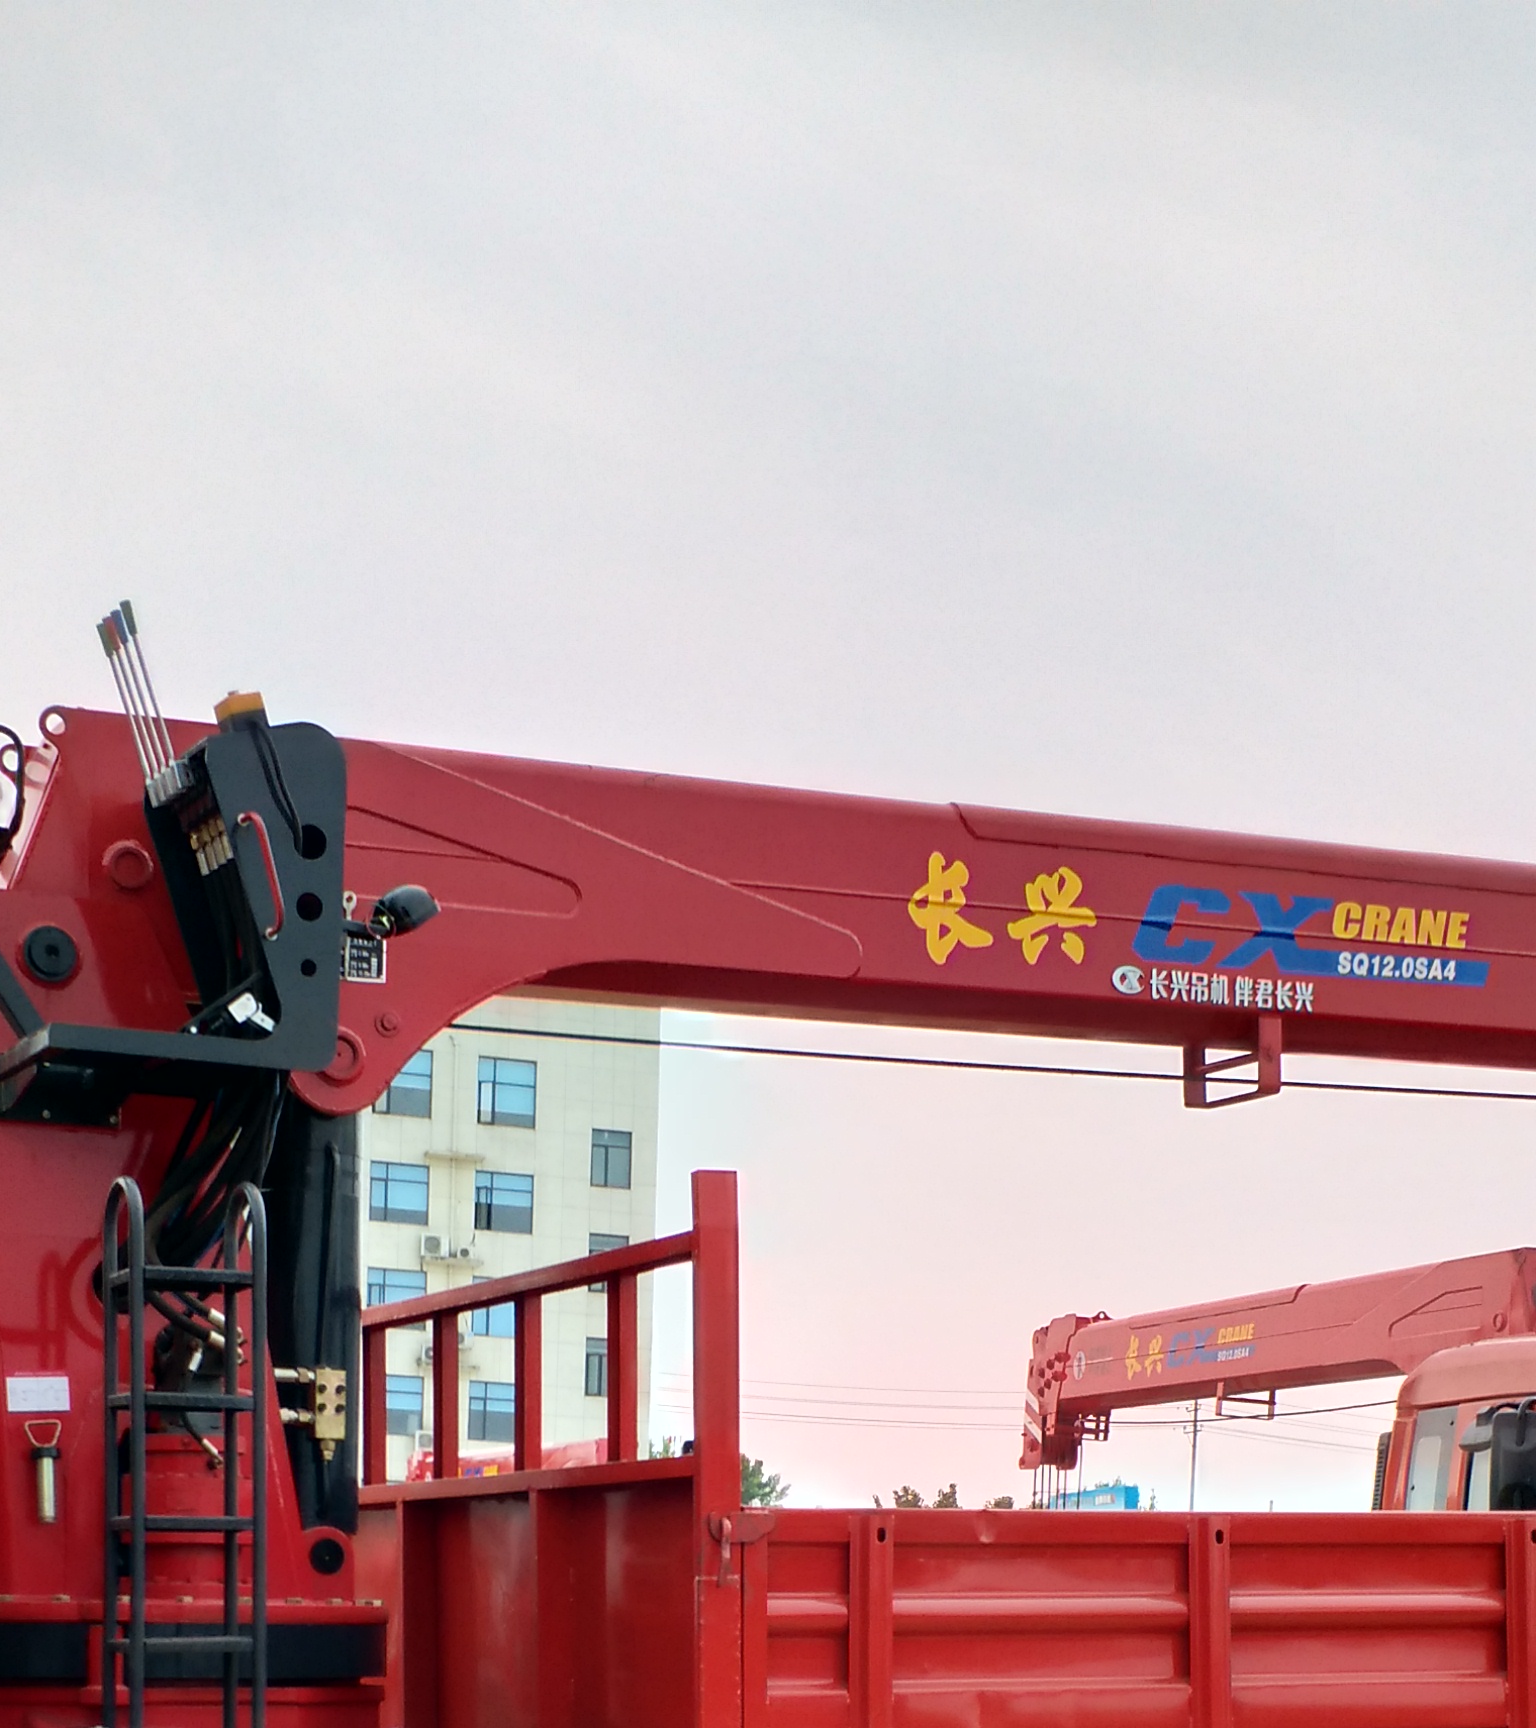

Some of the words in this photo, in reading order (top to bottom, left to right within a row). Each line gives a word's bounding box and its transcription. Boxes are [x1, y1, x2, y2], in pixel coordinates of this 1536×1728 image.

[908, 851, 1097, 965] 长兴
[1132, 884, 1334, 972] CX
[1332, 901, 1470, 949] CRANE
[1337, 951, 1457, 982] SQ12.0SA4
[1150, 968, 1229, 1006] 长兴吊机
[1235, 974, 1314, 1013] 伴君长兴
[1167, 1328, 1217, 1368] CX
[1217, 1322, 1255, 1345] CRANE
[1125, 1334, 1165, 1381] 长兴
